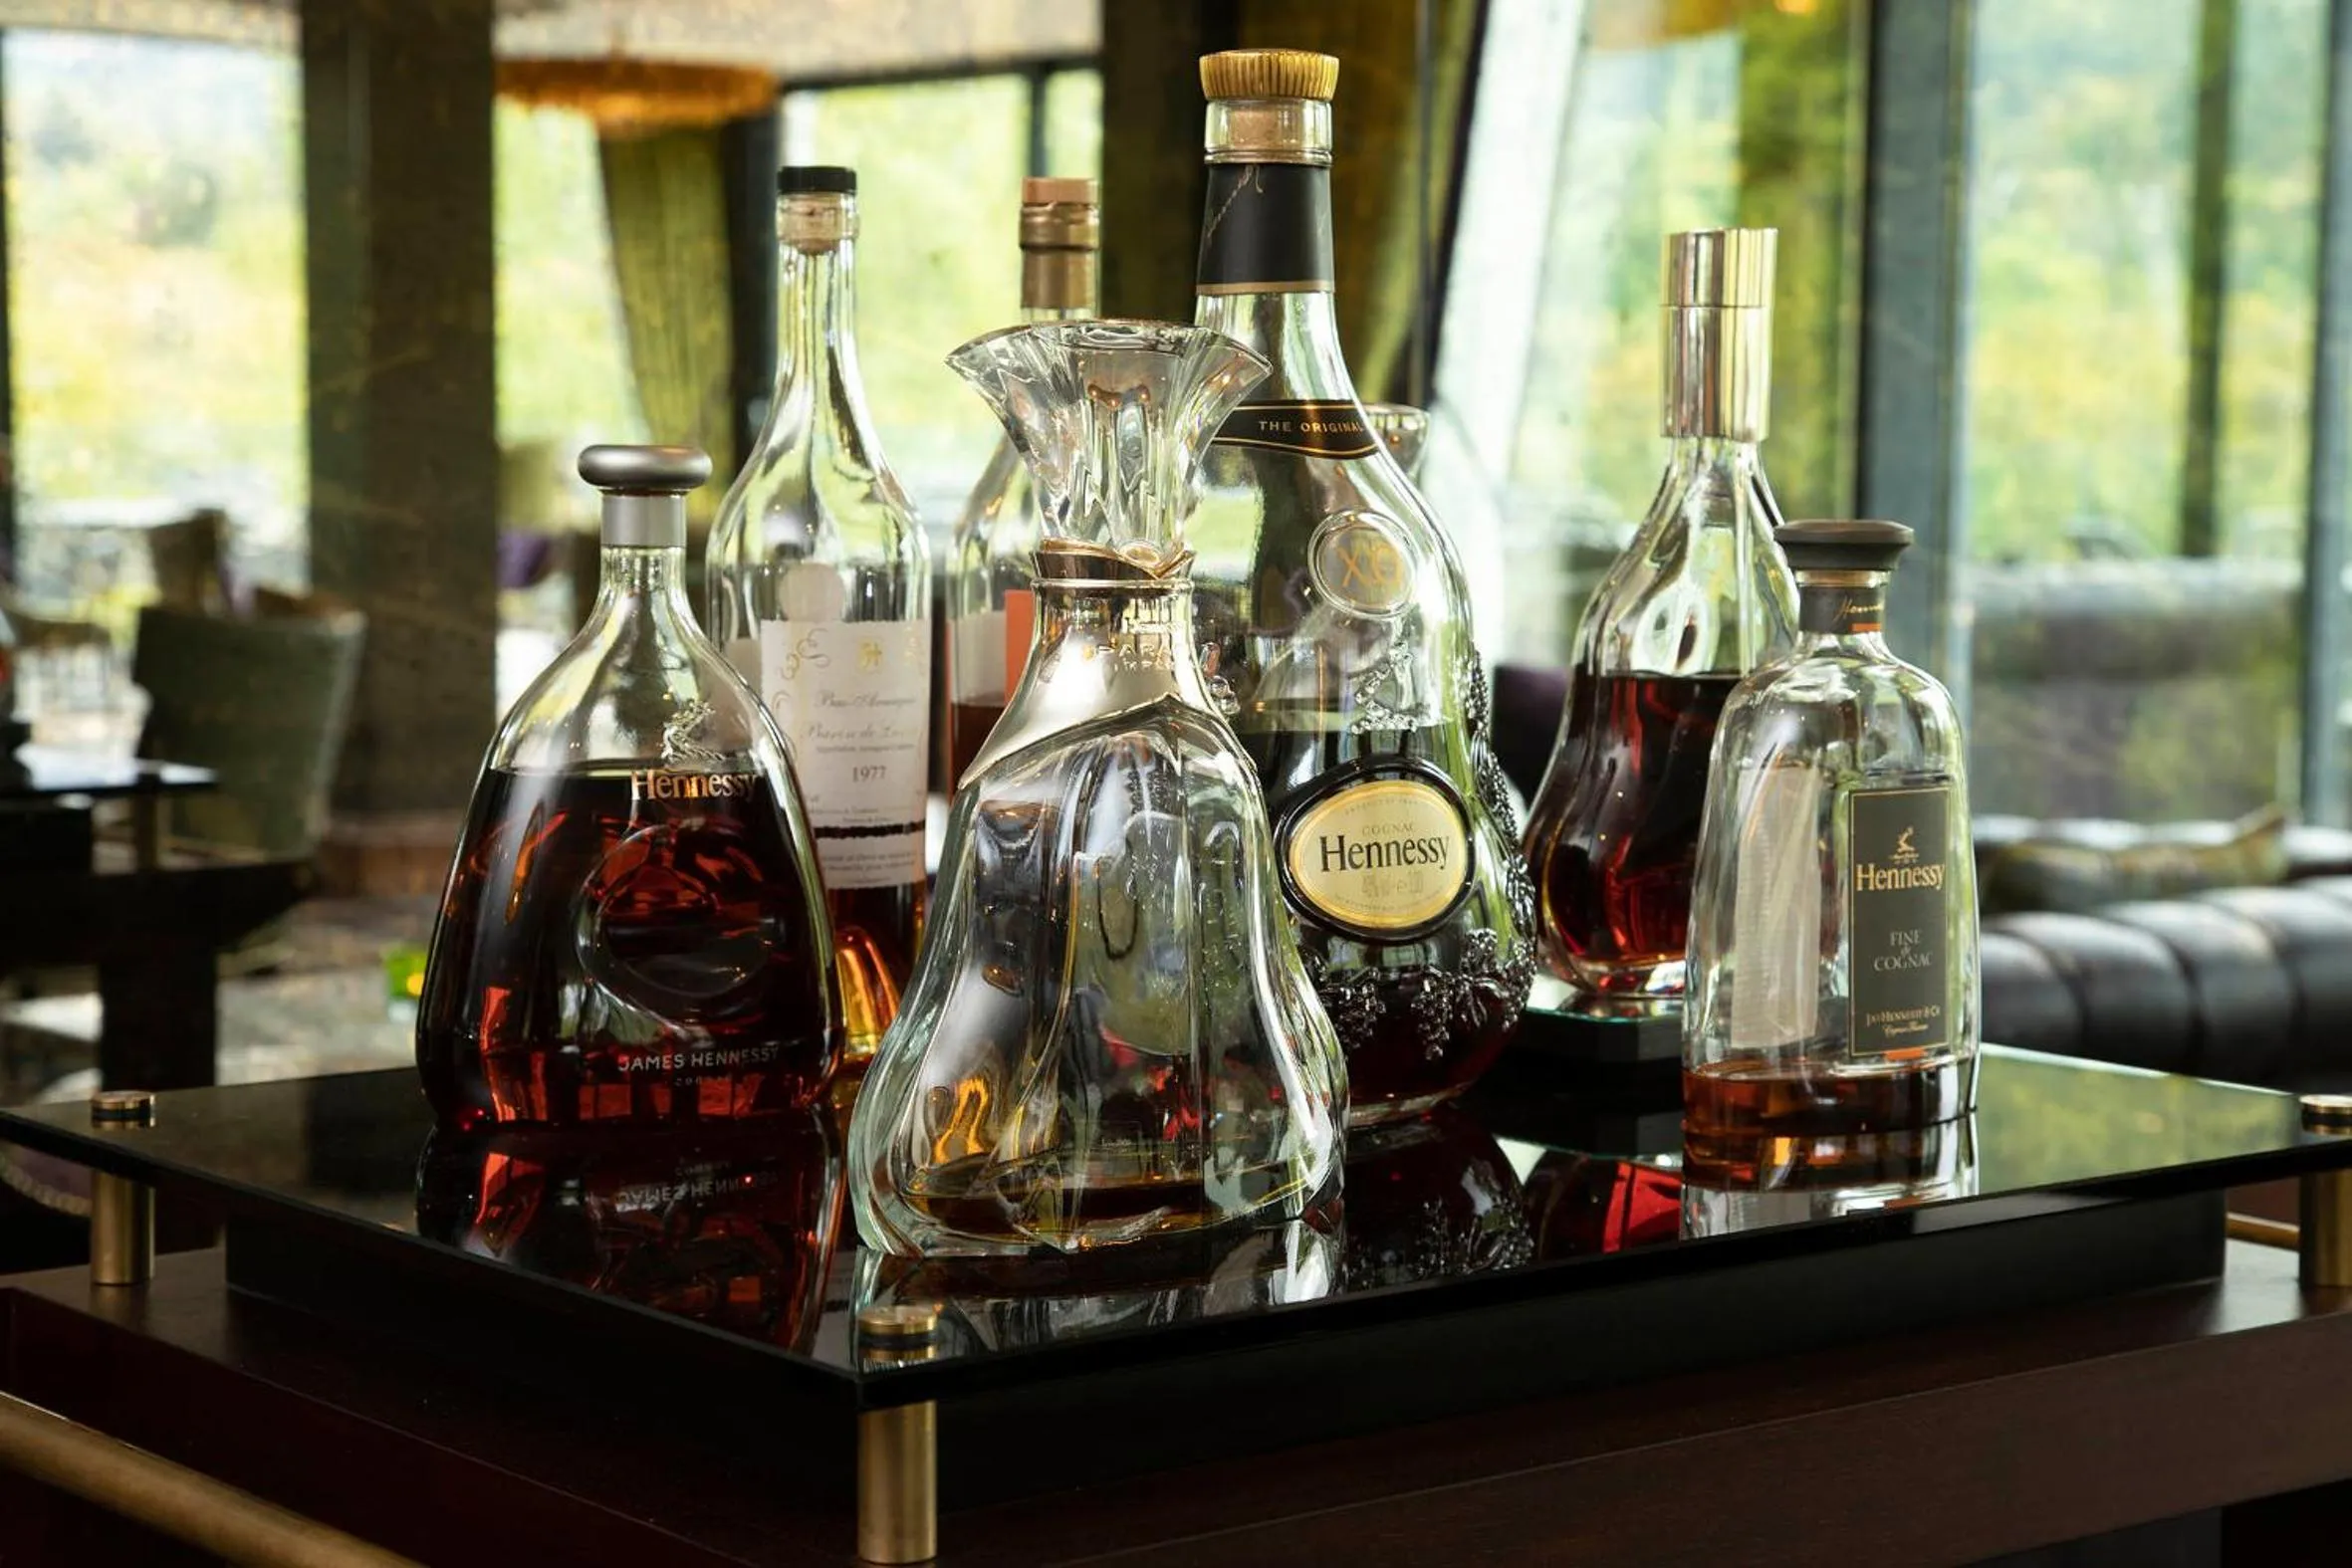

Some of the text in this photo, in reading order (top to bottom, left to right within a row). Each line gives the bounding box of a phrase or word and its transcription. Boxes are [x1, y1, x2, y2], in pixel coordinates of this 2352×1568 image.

[1259, 421, 1363, 433] THE ORIGINAL
[630, 769, 756, 801] Hennessy
[852, 766, 886, 783] 1977
[1319, 834, 1450, 872] Hennessy
[1856, 863, 1946, 891] Hennessy
[1890, 929, 1922, 946] FINE
[1873, 952, 1933, 972] COGNAC
[617, 1047, 779, 1072] JAMES HENNESSY
